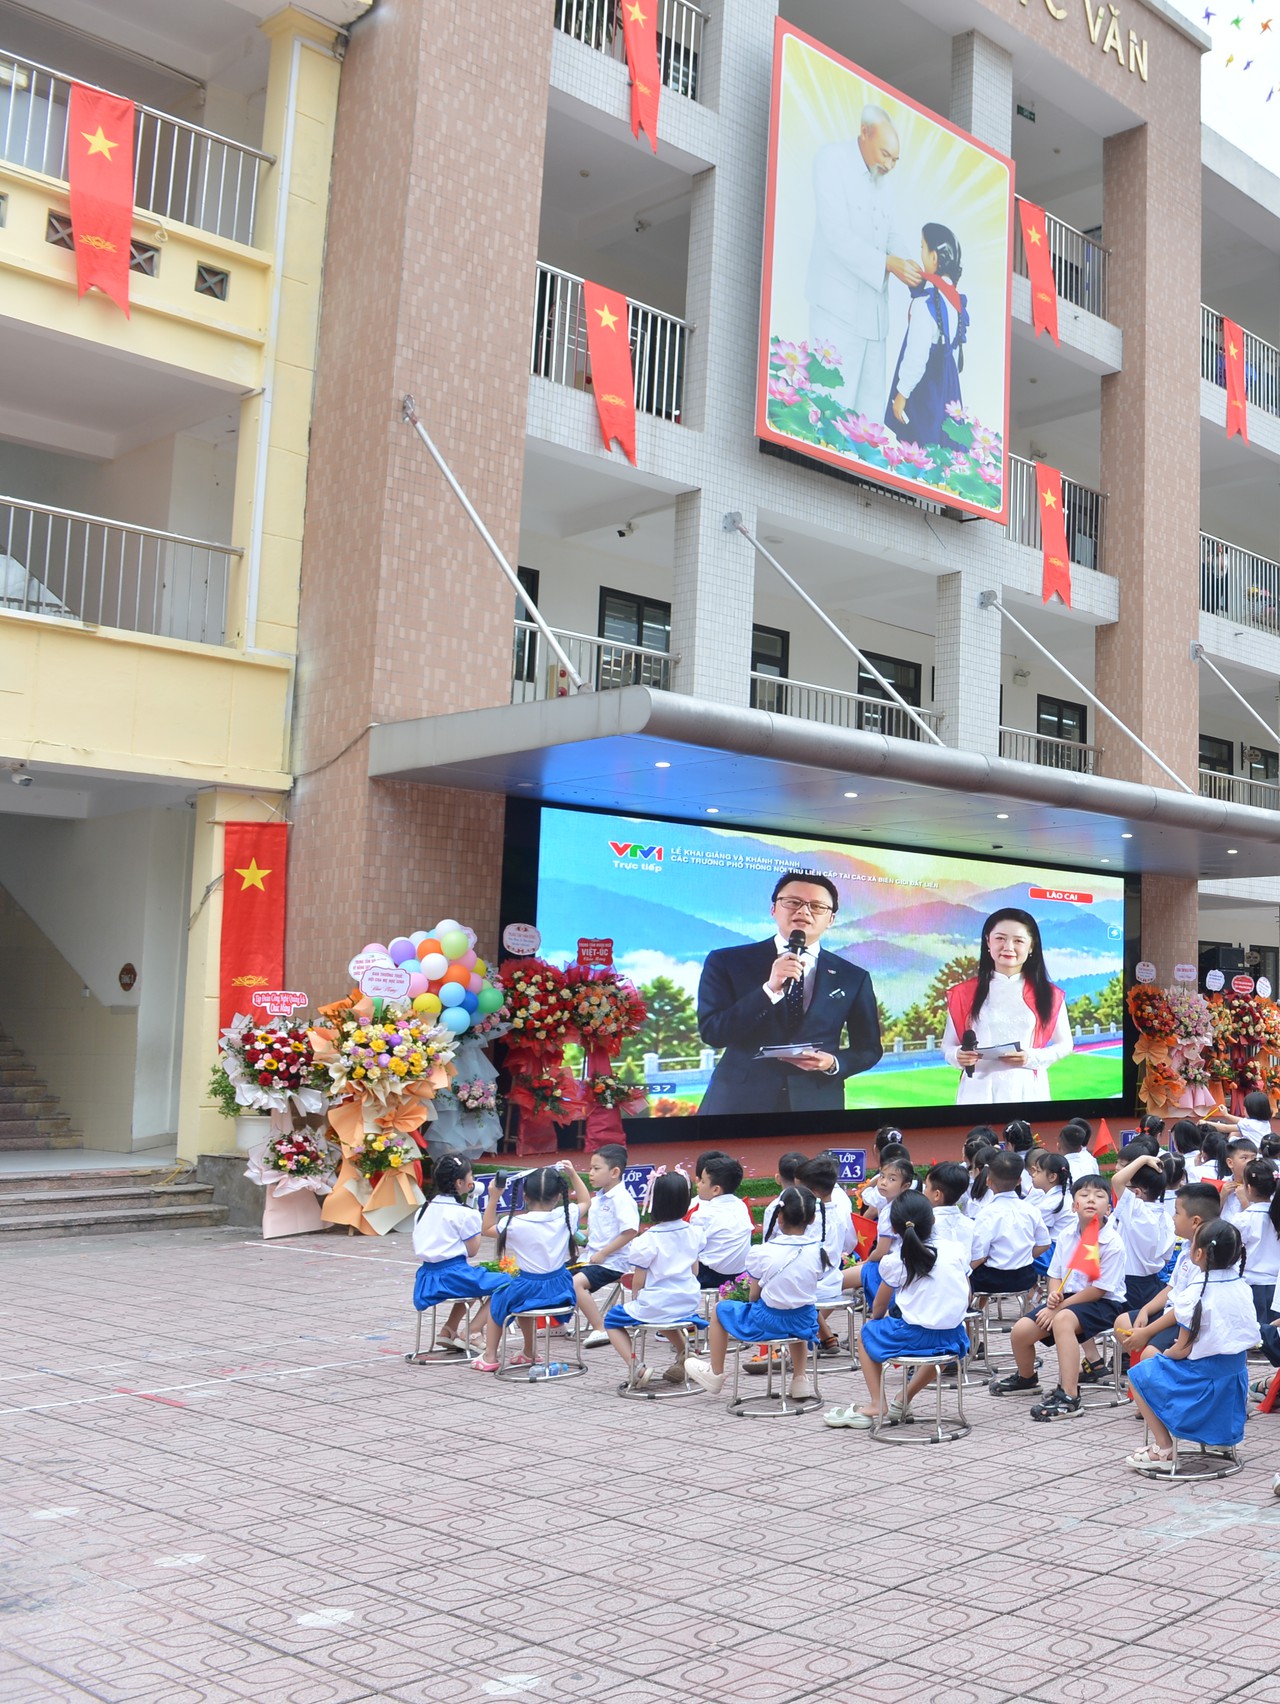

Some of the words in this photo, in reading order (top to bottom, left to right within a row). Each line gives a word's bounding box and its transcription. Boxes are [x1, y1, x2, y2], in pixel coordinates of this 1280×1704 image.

[1083, 0, 1148, 82] VĂN
[608, 841, 663, 861] VTV1
[684, 849, 704, 857] KHAI
[705, 850, 731, 860] GIẢNG
[745, 855, 773, 865] KHÁNH
[774, 859, 800, 868] THÀNH
[612, 860, 639, 870] Trực
[641, 863, 663, 873] tiếp
[671, 854, 688, 863] CÁC
[745, 863, 772, 871] THÔNG
[1046, 891, 1063, 899] LÀO
[1064, 893, 1078, 901] CAI
[839, 1152, 856, 1163] LỚP
[622, 1170, 643, 1182] LỚP
